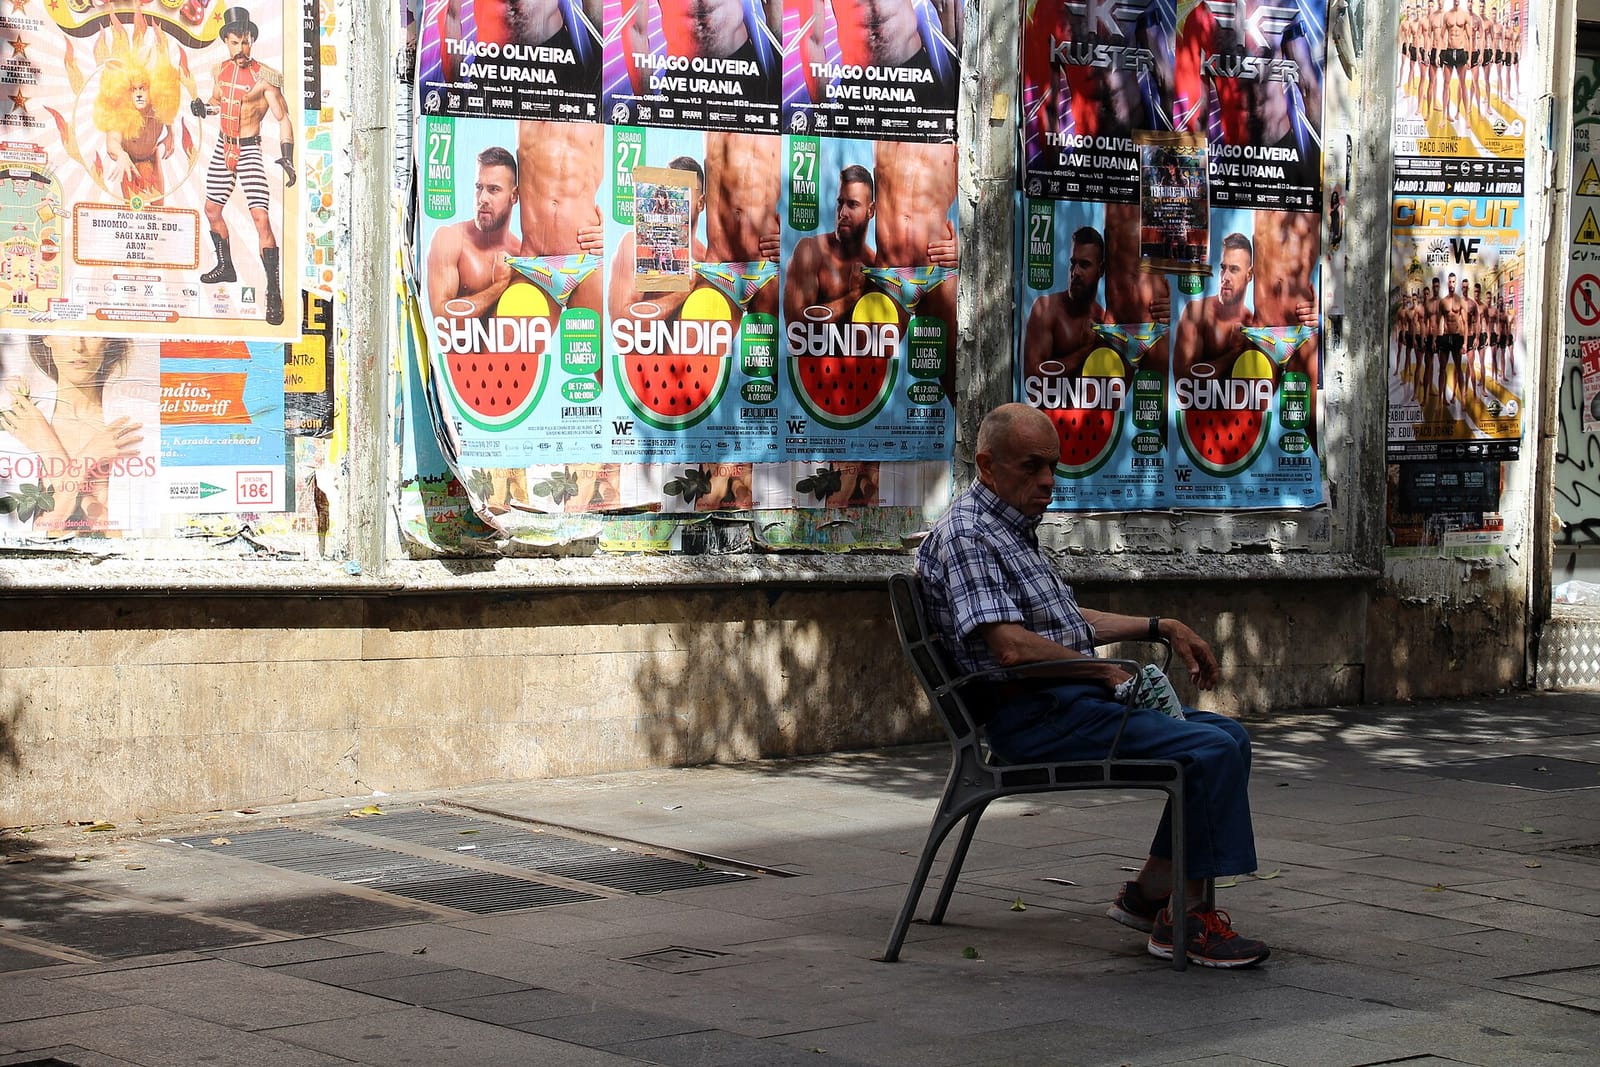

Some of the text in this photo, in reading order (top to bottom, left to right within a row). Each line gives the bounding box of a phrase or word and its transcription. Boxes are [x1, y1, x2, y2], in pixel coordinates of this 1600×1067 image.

[445, 38, 577, 65] THIAGO OLIVEIRA
[632, 52, 760, 77] THIAGO OLIVEIRA
[459, 62, 558, 84] DAVE URANIA
[809, 62, 935, 84] THIAGO OLIVEIRA
[649, 75, 744, 95] DAVE URANIA
[825, 84, 916, 102] DAVE URANIA
[793, 142, 817, 152] SABADO
[1045, 131, 1094, 149] THIAGO
[1418, 141, 1436, 153] PACO
[1437, 141, 1459, 153] JOHNS
[428, 133, 453, 165] 27
[1206, 143, 1299, 162] HIAGO OLIVEIRA
[616, 143, 642, 173] 27
[1058, 152, 1139, 171] DAVE URANIA
[428, 165, 452, 180] MAYO
[792, 151, 817, 181] 27
[1209, 162, 1285, 179] DAVE URANIA
[617, 172, 634, 187] MAY
[792, 181, 816, 194] MAYO
[1419, 180, 1425, 192] 3
[1424, 180, 1446, 193] JUNIO
[1453, 182, 1481, 194] MADRID
[1485, 183, 1496, 194] LA
[1495, 183, 1523, 195] RIVIERA
[117, 212, 157, 221] PACO JOHNS
[792, 207, 815, 219] FABRIK
[1392, 198, 1520, 228] CIRCUIT
[92, 219, 178, 232] BINOMIO SR. EDU
[1030, 214, 1052, 242] 27
[115, 232, 159, 241] SAGI KARIV
[126, 242, 146, 250] ARON
[1030, 242, 1051, 255] MAYO
[1449, 237, 1482, 265] WE
[126, 252, 146, 260] ABEL
[745, 323, 774, 335] BINOMIO
[913, 326, 941, 338] BINOMIO
[569, 341, 592, 353] LUCAS
[748, 346, 770, 357] LUCAS
[915, 347, 938, 359] LUCAS
[565, 352, 597, 365] FLAMEFLY
[744, 356, 775, 369] FLAMEFLY
[911, 358, 942, 370] FLAMEFLY
[182, 400, 232, 416] Sheriff
[1139, 399, 1158, 411] LUCAS
[1286, 401, 1304, 412] LUCAS
[1135, 410, 1162, 422] FLAMEFLY
[1283, 411, 1307, 422] FLAMEFLY
[1406, 410, 1424, 421] LUIGI
[611, 420, 635, 436] WE
[786, 419, 808, 434] WE
[1174, 468, 1193, 483] WE
[240, 484, 269, 499] 18€
